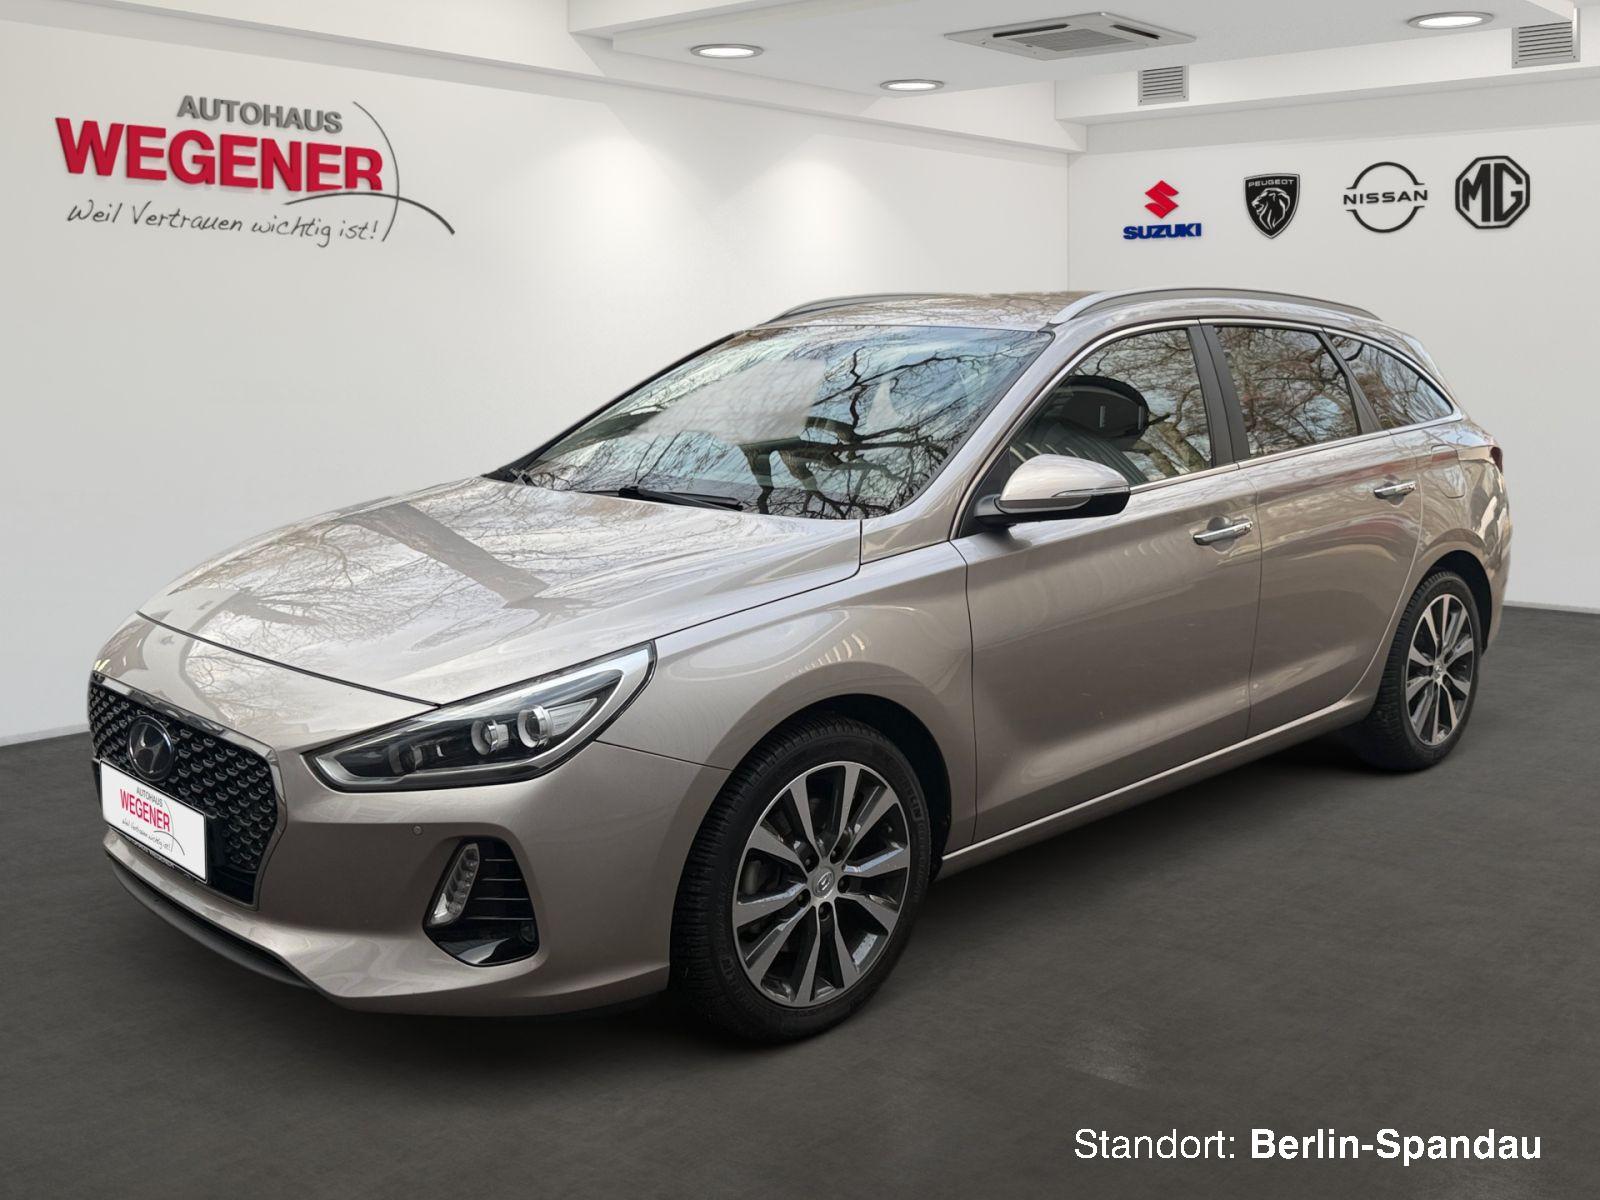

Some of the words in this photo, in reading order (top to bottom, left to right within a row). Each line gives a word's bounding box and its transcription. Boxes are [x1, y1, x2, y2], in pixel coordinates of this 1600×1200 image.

[177, 95, 343, 133] AUTOHAUS
[55, 117, 383, 192] WEGENER
[1248, 179, 1295, 187] PEUGEOT
[1343, 189, 1428, 206] NISSAN
[1462, 163, 1523, 222] MG
[67, 198, 123, 223] Weil
[132, 200, 243, 232] Vertrauen
[251, 215, 331, 248] wichtig
[339, 220, 378, 240] ist!
[1123, 222, 1202, 241] SUZUKI
[120, 789, 170, 832] WEGENER
[136, 787, 163, 807] AUTOHAUS
